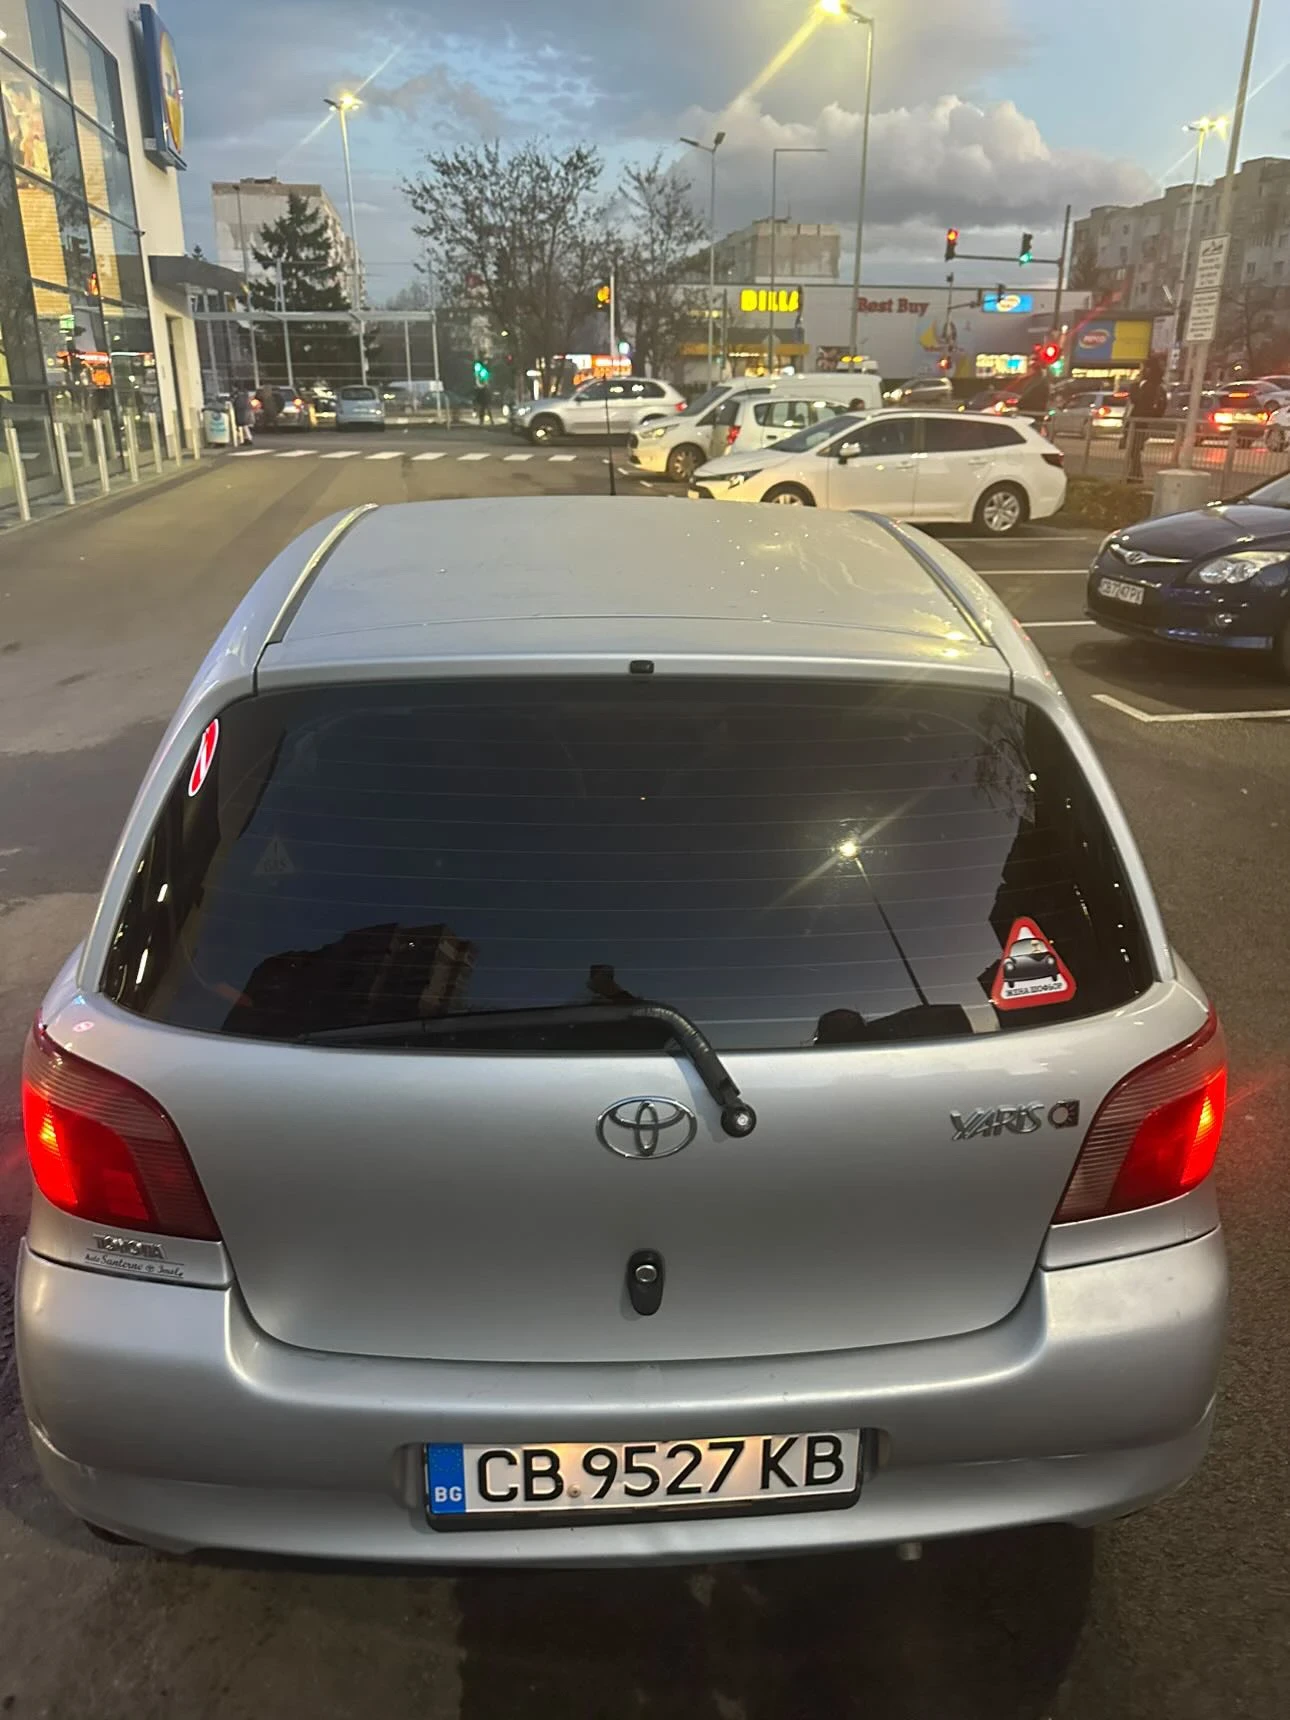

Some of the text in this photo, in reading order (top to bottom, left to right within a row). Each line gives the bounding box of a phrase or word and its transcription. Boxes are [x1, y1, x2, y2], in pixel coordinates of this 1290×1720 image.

[857, 297, 929, 317] Best Buy
[950, 1101, 1045, 1141] YARIS
[93, 1234, 167, 1260] TOYOTA
[477, 1435, 845, 1502] CB 9527 KB
[434, 1486, 463, 1503] BG
